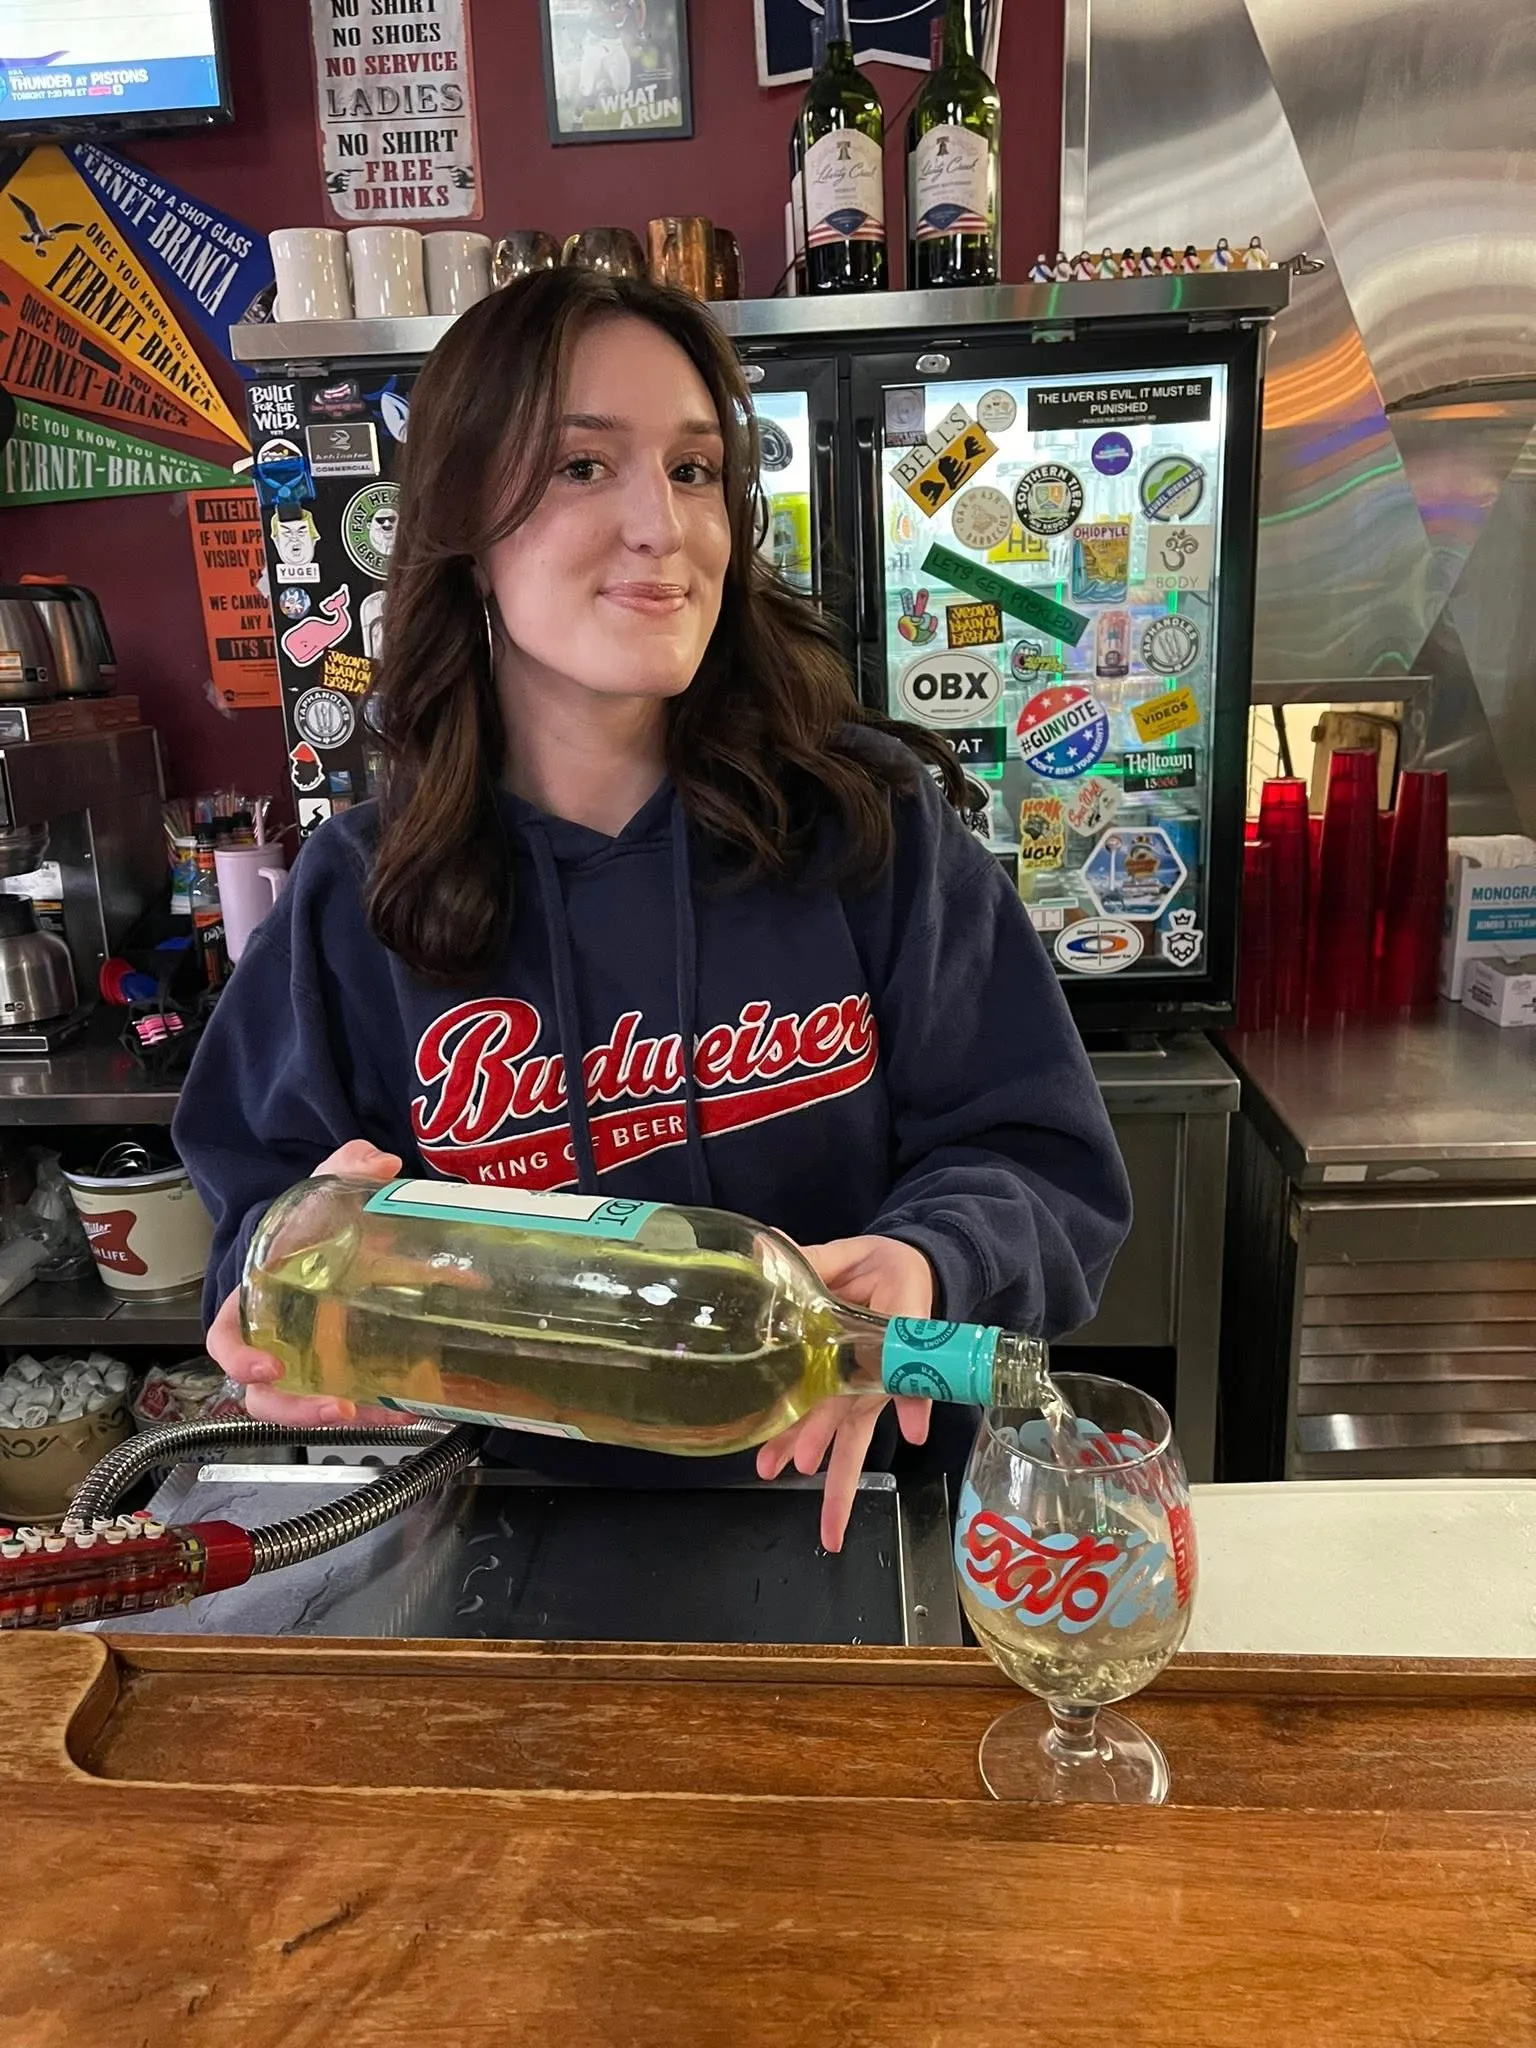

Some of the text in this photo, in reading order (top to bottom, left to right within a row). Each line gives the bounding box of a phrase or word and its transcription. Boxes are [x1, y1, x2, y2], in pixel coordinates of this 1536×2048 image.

[332, 0, 437, 18] NO SHIRT
[333, 23, 441, 47] NO SHOES
[326, 51, 457, 77] NO SERVICE
[9, 68, 149, 90] THUNDER AT PISTONS
[327, 84, 464, 117] LADIES
[601, 84, 658, 115] WHAT
[620, 97, 678, 129] A RUN
[338, 129, 458, 156] NO SHIRT
[365, 159, 433, 183] FREE
[84, 143, 252, 258] IREWORKS IN A SHOT GLASS
[354, 186, 450, 210] DRINKS
[73, 143, 240, 317] FERNET-BRANCA
[86, 222, 118, 263] ONCE
[115, 260, 141, 290] YOU
[139, 291, 169, 335] KNOW,
[171, 334, 188, 359] YOU
[44, 243, 211, 412] FERNET-BRANCA
[19, 293, 53, 331] ONCE
[53, 319, 79, 349] YOU
[129, 371, 152, 395] YOU
[1, 327, 189, 427] FERNET-BRANCA
[248, 384, 296, 404] BUILT
[1037, 385, 1202, 404] THE LIVER IS EVIL, IT MUST BE
[252, 402, 295, 413] FOR THE
[1090, 402, 1149, 415] PUNISHED
[252, 411, 300, 431] WILD.
[17, 410, 38, 431] CE
[44, 417, 69, 438] YOU
[77, 428, 121, 451] KNOW,
[127, 444, 153, 458] YOU
[897, 412, 968, 482] BELL'S
[4, 438, 203, 493] FERNET-BRANCA
[316, 465, 371, 473] COMMERCIAL
[1017, 466, 1082, 510] SOUTHERN TIER
[204, 501, 261, 520] ATTENTI
[352, 503, 368, 532] FAT
[200, 529, 262, 546] IF YOU APP
[1073, 526, 1129, 538] OHIOPYLE
[204, 550, 249, 568] VISIBLY
[280, 567, 317, 577] YUGE!
[1156, 576, 1199, 589] BODY
[975, 576, 1007, 599] GET
[210, 596, 269, 611] WE CANNO
[240, 616, 261, 630] ANY
[230, 640, 259, 659] IT'S
[1144, 617, 1197, 658] TAPHANDLES
[913, 672, 989, 701] OBX
[300, 692, 350, 721] TAPHANDLES
[1142, 701, 1188, 725] VIDEOS
[1021, 700, 1098, 755] #GUNVOTE
[1075, 752, 1096, 770] YOUR
[1124, 752, 1192, 774] Helltown
[1022, 797, 1061, 821] HONK
[1023, 845, 1061, 860] UGLY
[411, 992, 874, 1145] Budweiser
[478, 1149, 548, 1183] KING
[612, 1115, 685, 1149] BEER
[101, 1248, 128, 1261] LIFE
